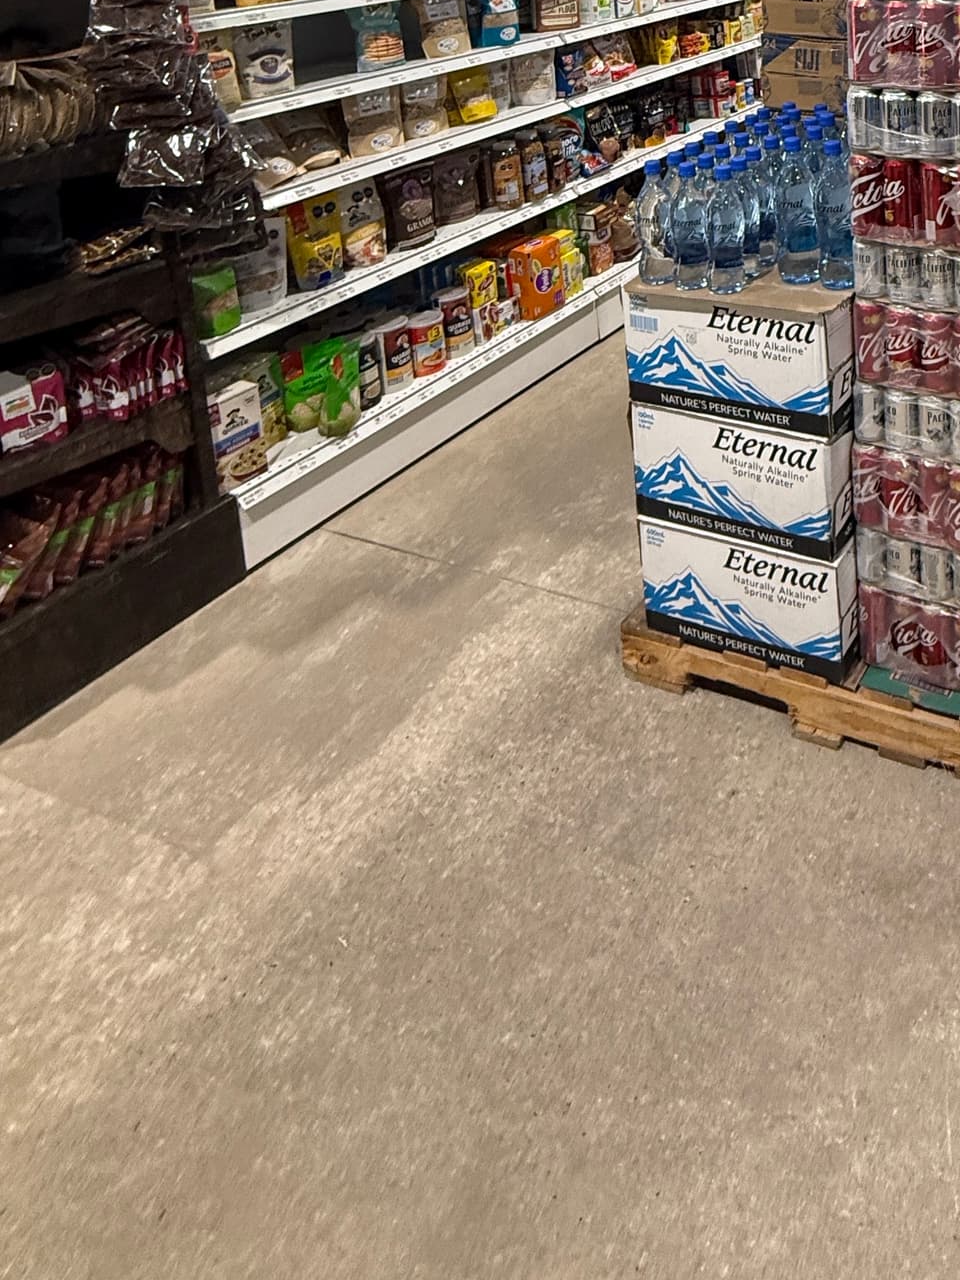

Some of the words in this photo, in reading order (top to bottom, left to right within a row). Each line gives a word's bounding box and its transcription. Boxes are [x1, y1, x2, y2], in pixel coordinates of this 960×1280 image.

[707, 305, 816, 345] Eternal
[716, 332, 761, 350] Naturally
[763, 341, 805, 356] Alkaline
[727, 344, 759, 359] Spring
[761, 348, 793, 363] Water
[660, 392, 708, 410] NATURE'S
[708, 401, 751, 419] PERFECT
[752, 409, 791, 426] WATER
[712, 426, 818, 472] Eternal
[721, 453, 766, 474] Naturally
[766, 464, 806, 483] Alkaline
[732, 466, 762, 483] Spring
[765, 474, 794, 489] Water
[667, 508, 713, 529] NATURE'S
[713, 518, 756, 539] PERFECT
[756, 530, 794, 548] WATER
[723, 547, 829, 593] Eternal
[732, 573, 776, 594] Naturally
[778, 586, 818, 604] Alkaline
[743, 587, 774, 603] Spring
[776, 595, 807, 609] Water
[678, 624, 724, 646] NATURE'S
[725, 634, 767, 657] PERFECT
[767, 649, 806, 668] WATER
